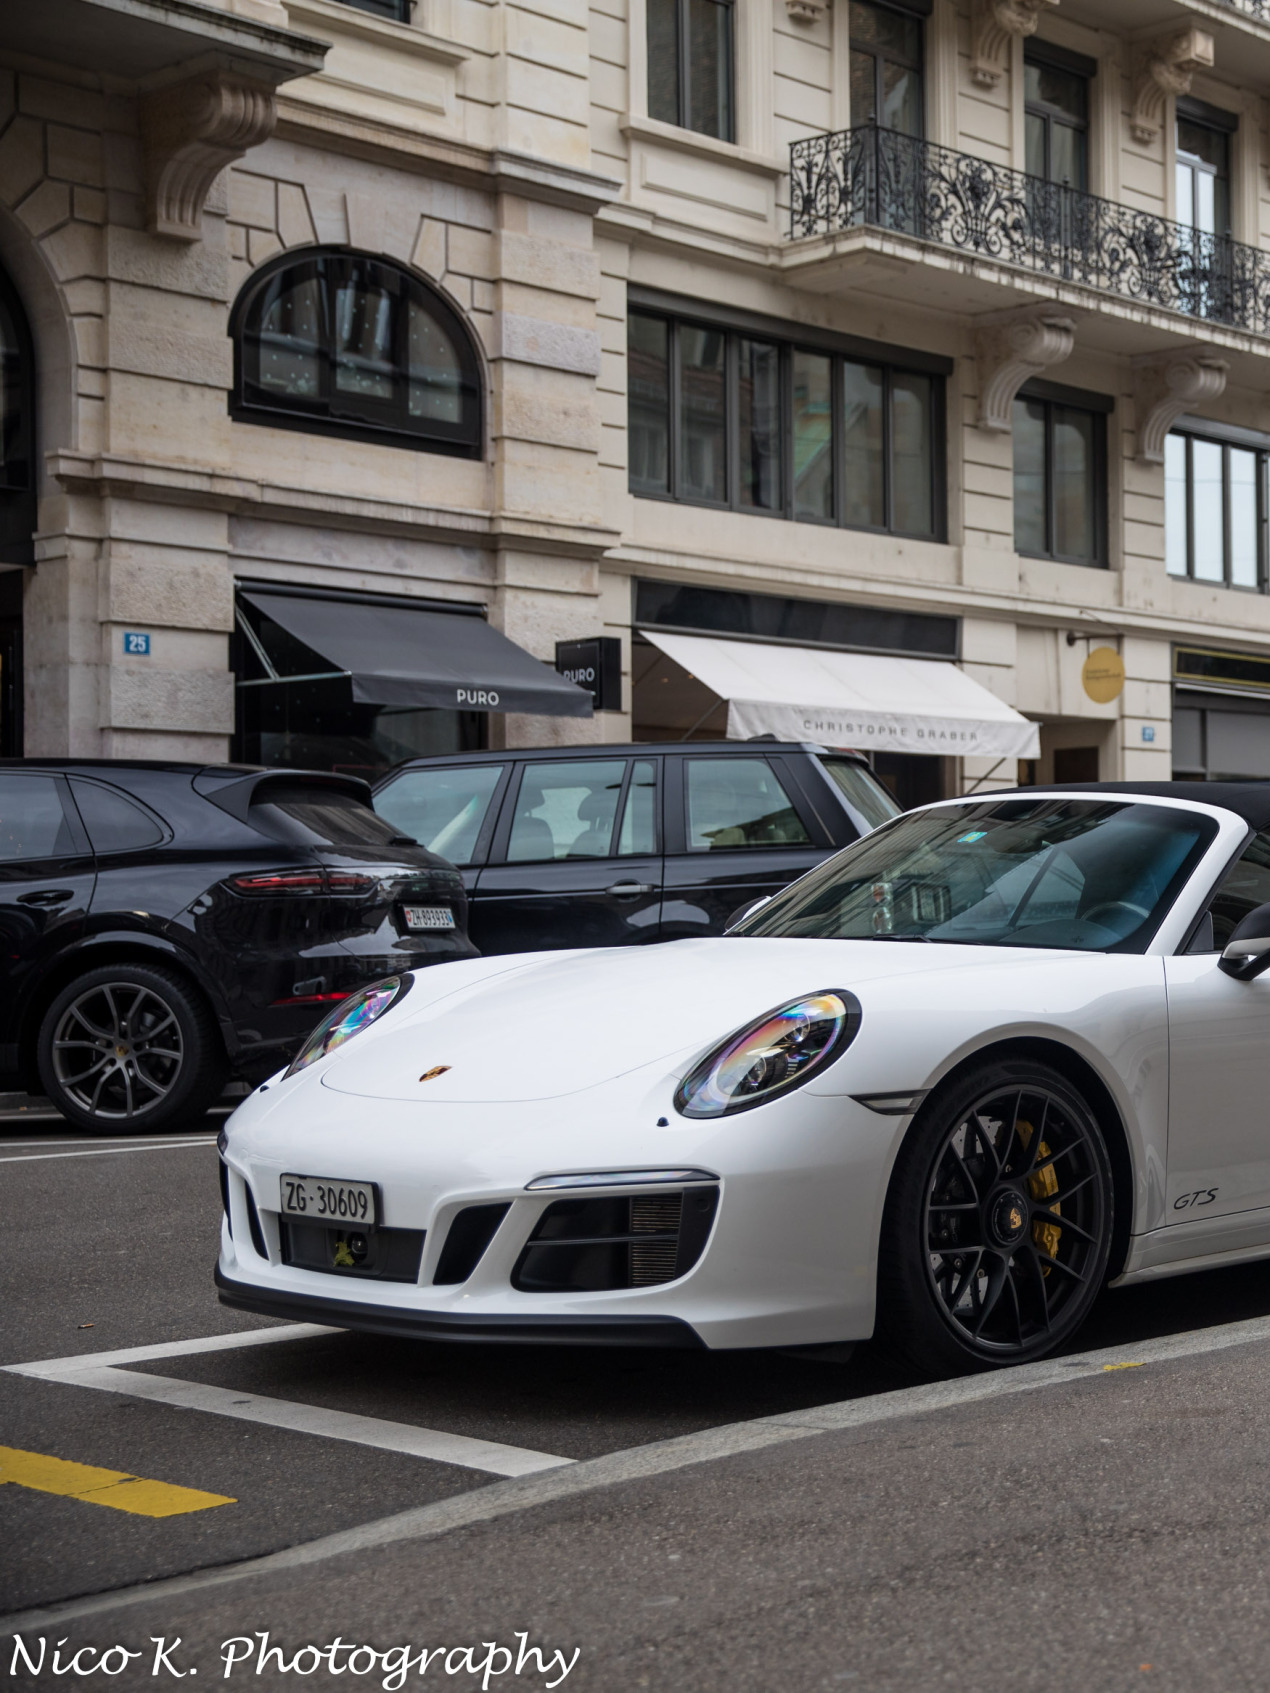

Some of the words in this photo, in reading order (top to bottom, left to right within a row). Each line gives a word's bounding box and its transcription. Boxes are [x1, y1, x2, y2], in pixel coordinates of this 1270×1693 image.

[128, 634, 147, 653] 25
[563, 667, 596, 685] PURO
[456, 688, 500, 707] PURO
[802, 719, 908, 737] CHRISTOPHE
[916, 728, 978, 742] GRABER
[1174, 1187, 1219, 1210] GTS
